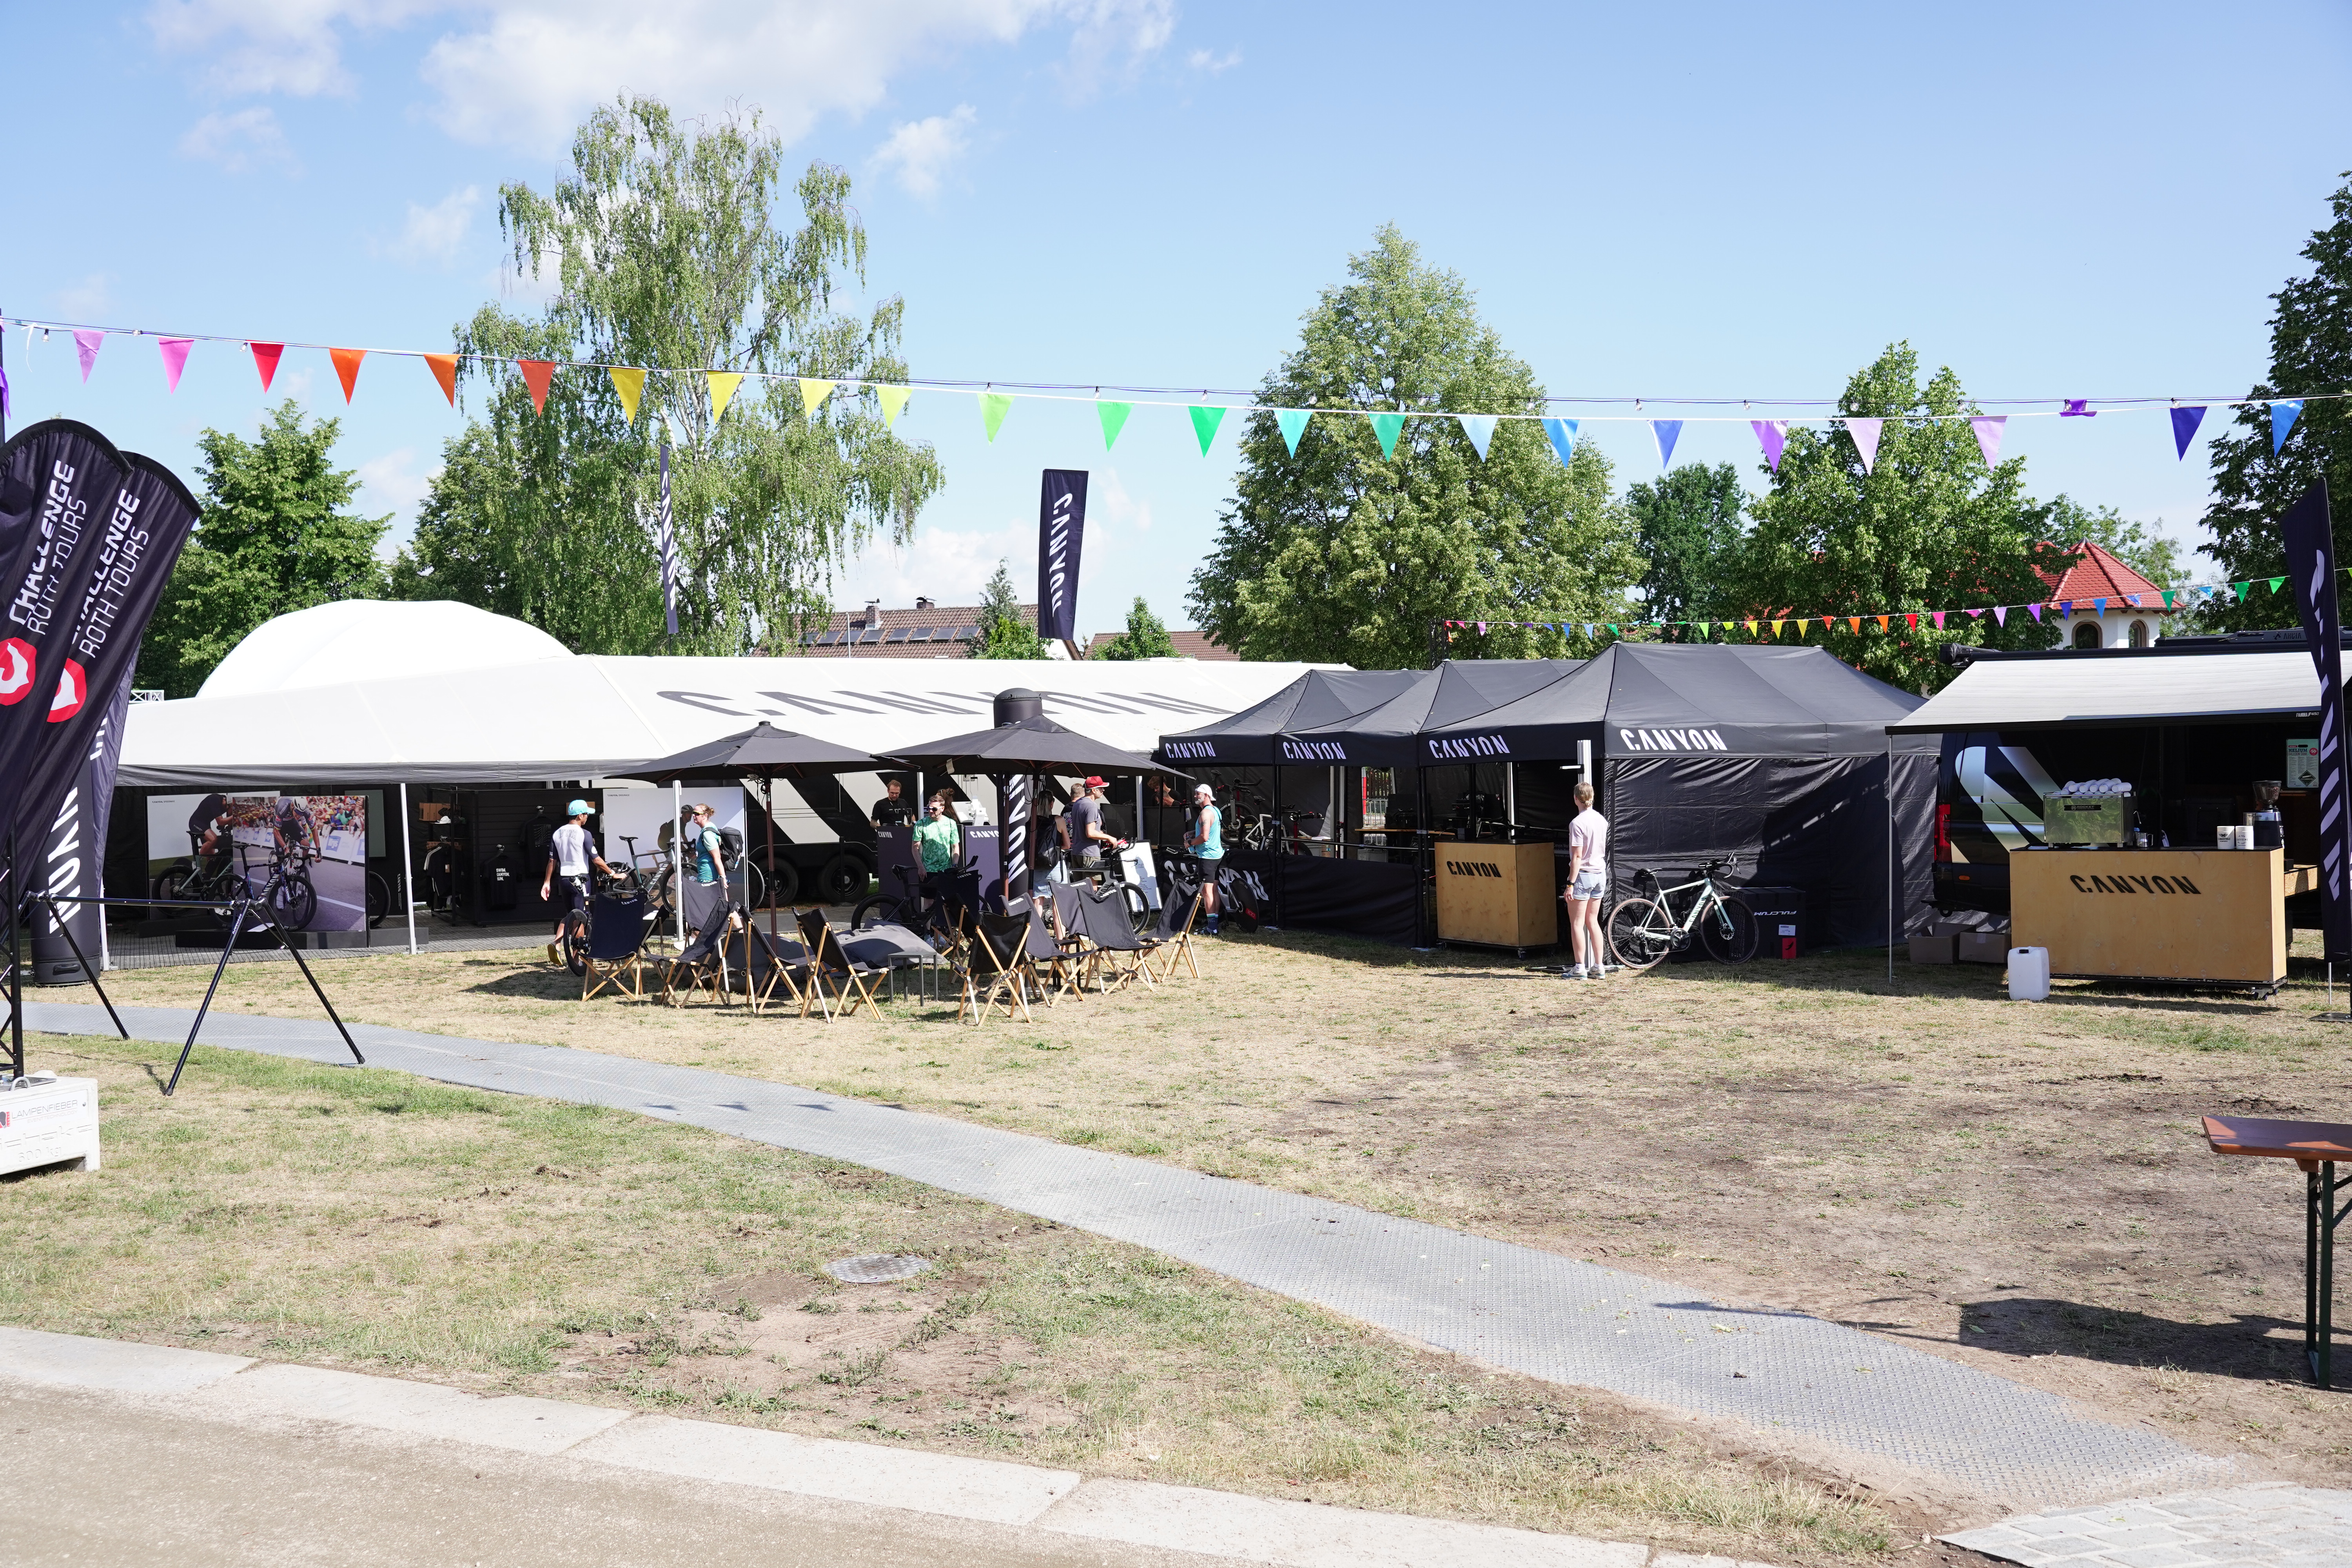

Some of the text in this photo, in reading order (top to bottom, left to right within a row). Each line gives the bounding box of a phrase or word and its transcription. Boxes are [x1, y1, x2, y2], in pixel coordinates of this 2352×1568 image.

[10, 460, 74, 624] CHALLENGE
[662, 471, 676, 610] CANYON
[28, 496, 87, 635] ROTH TOURS
[72, 488, 140, 644] ALLENGE
[1049, 493, 1073, 618] CANYON
[79, 526, 149, 658] ROTH TOURS
[1165, 741, 1216, 758] CANYON
[1283, 742, 1347, 759] CANYON
[1429, 735, 1510, 758] CANYON
[1620, 729, 1728, 751] CANYON
[650, 864, 669, 885] CANYON
[1446, 860, 1502, 878] CANYON
[2070, 875, 2201, 894] CANYON
[1689, 897, 1708, 922] CANYON
[12, 1100, 78, 1119] LAMPENFIEBER
[27, 1110, 78, 1123] EVENTTECHNOLOGY
